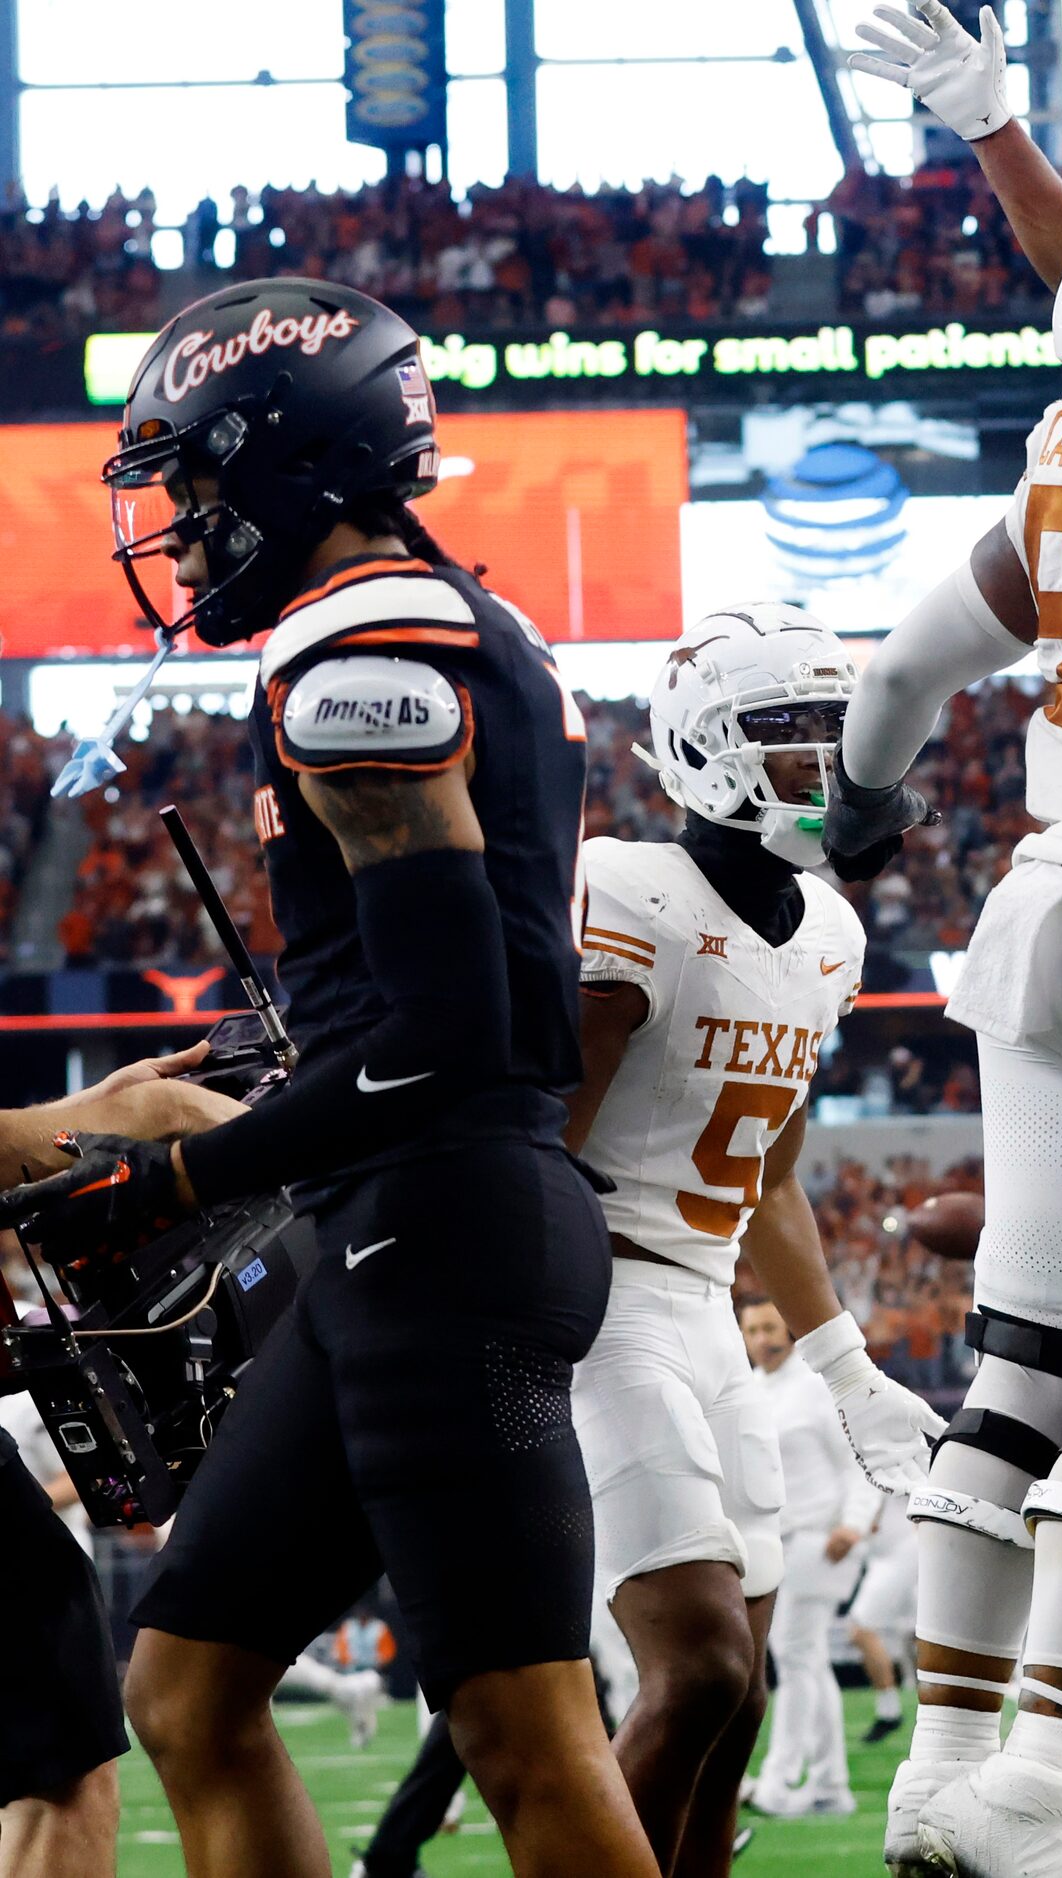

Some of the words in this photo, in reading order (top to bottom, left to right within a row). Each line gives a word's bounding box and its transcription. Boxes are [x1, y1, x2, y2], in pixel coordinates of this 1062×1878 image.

[163, 309, 359, 402] Cowboys
[419, 333, 497, 389] big
[504, 331, 628, 378] wins
[634, 330, 708, 376] for
[713, 326, 858, 373] small
[315, 696, 429, 730] DOUGLAS
[697, 932, 729, 959] XII
[694, 1016, 823, 1081] TEXAS
[675, 1081, 798, 1239] 5
[242, 1263, 263, 1285] v3.20
[913, 1495, 970, 1515] DONJOY
